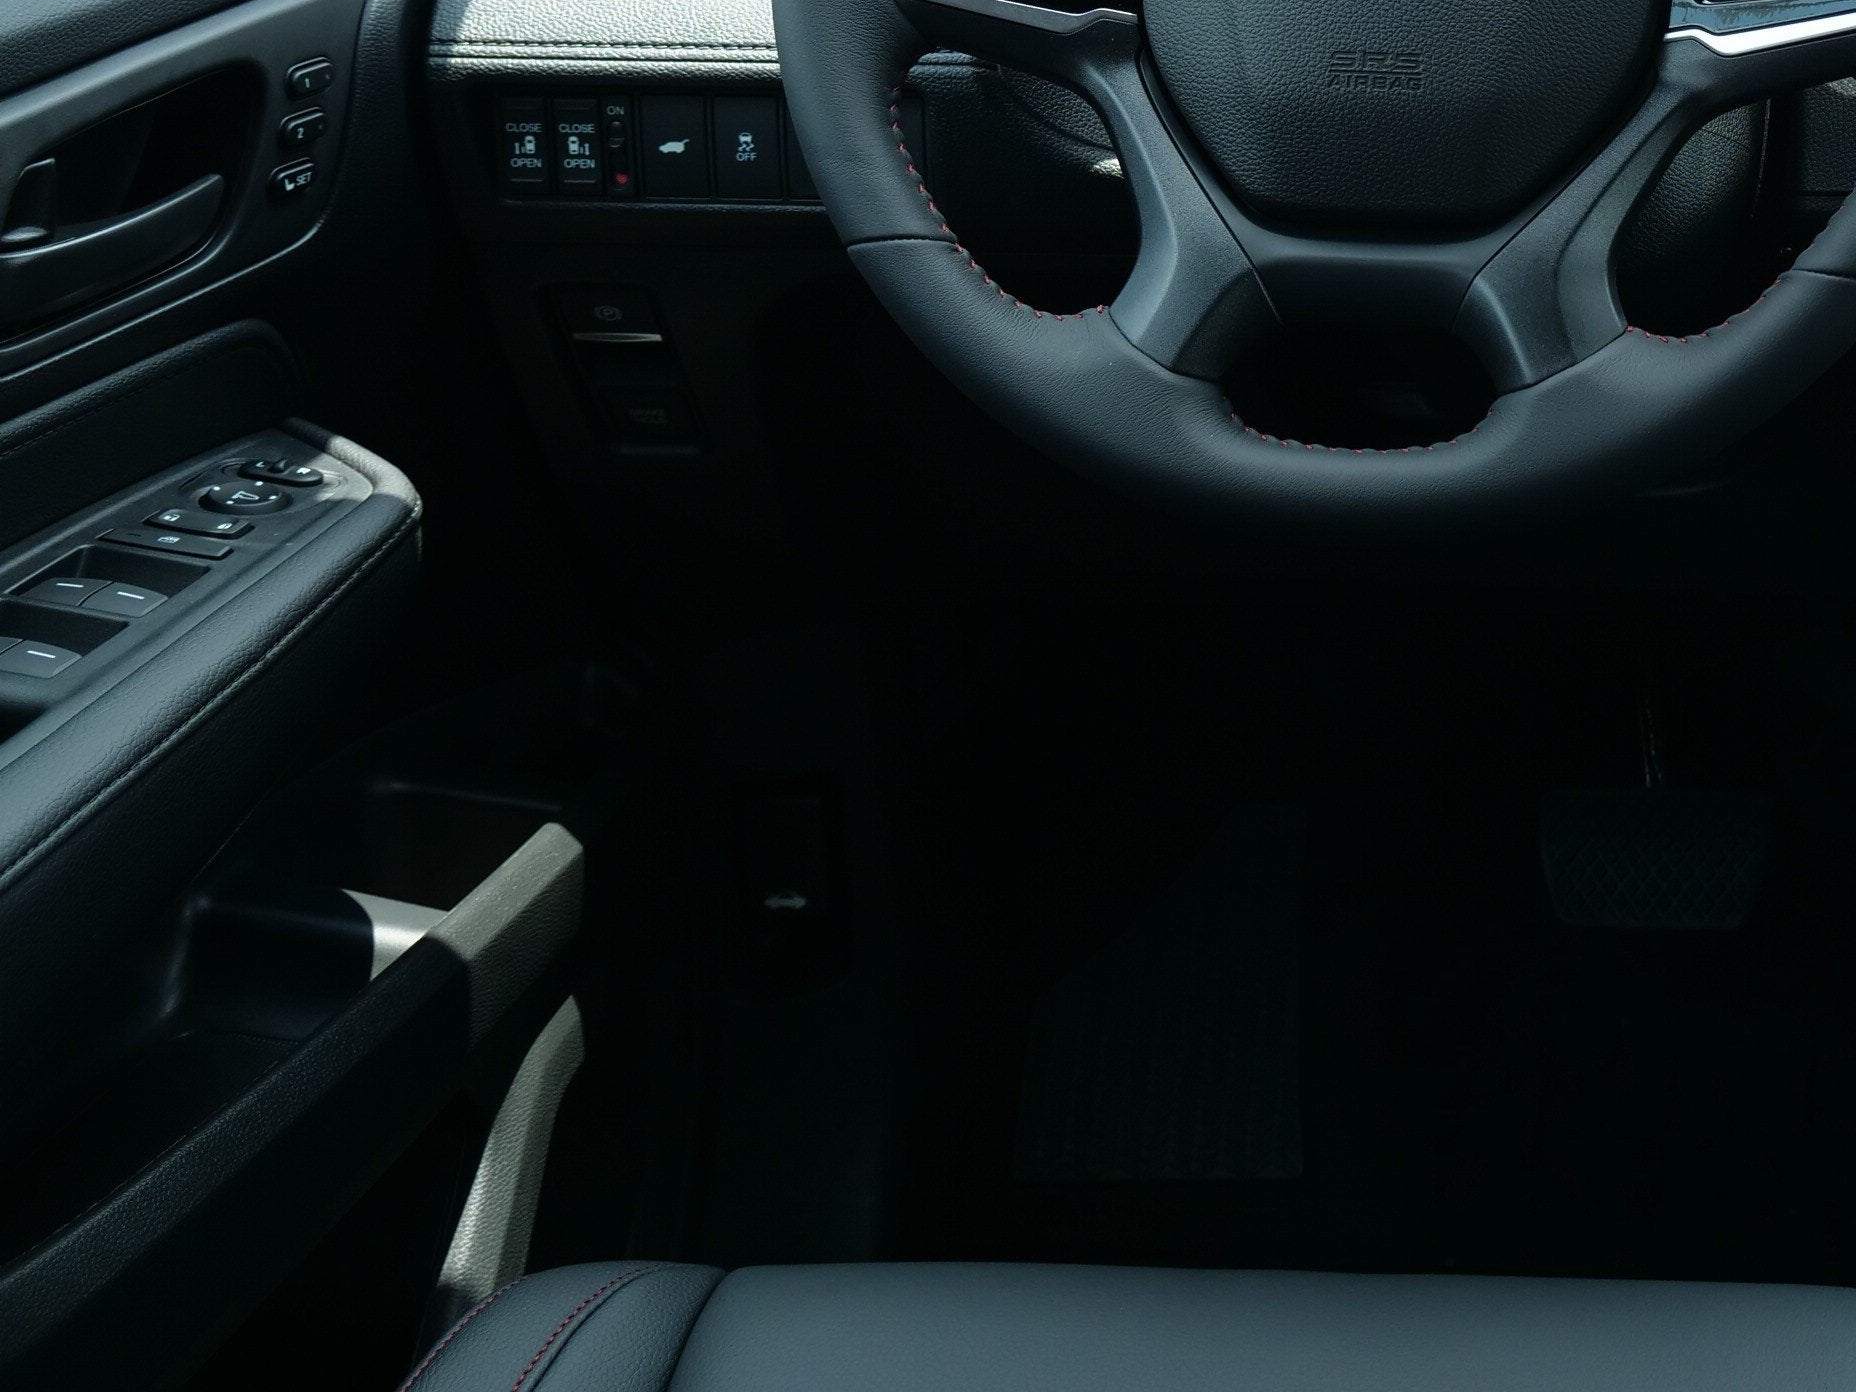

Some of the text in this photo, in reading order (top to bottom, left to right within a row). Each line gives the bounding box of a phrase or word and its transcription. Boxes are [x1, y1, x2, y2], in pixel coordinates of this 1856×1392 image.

[1330, 75, 1425, 92] AIRBAG
[607, 106, 625, 115] ON
[505, 123, 542, 133] CLOSE
[558, 123, 595, 134] CLOSE
[297, 128, 304, 139] 2
[736, 152, 757, 161] OFF
[510, 158, 542, 168] OPEN
[563, 159, 595, 169] OPEN
[296, 172, 312, 186] SET
